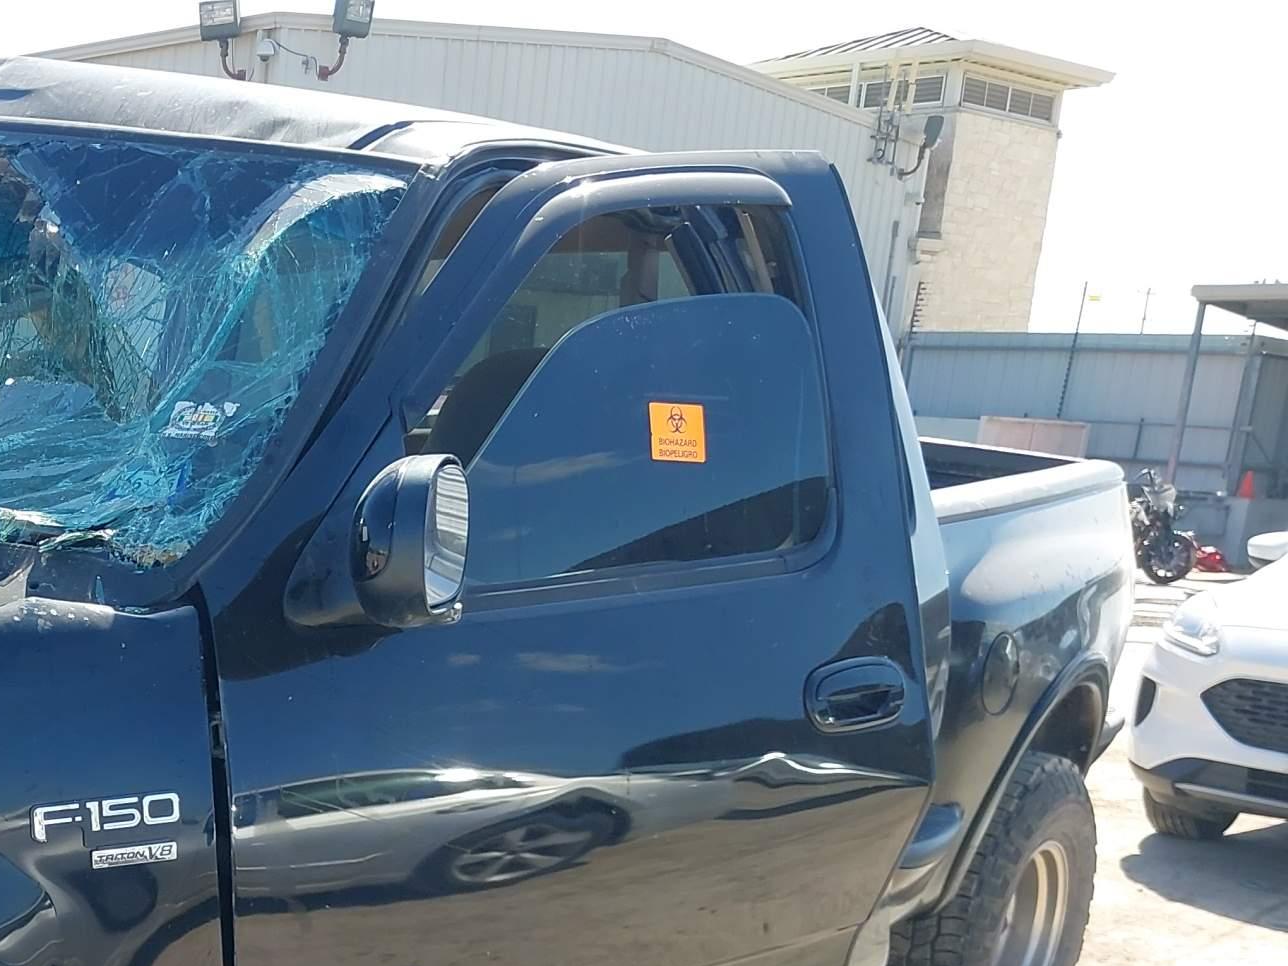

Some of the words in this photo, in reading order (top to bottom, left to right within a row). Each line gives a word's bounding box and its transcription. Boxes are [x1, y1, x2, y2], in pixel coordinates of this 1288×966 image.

[658, 436, 697, 448] BIOHAZARD
[658, 448, 698, 459] BIOPELIGRO
[33, 792, 180, 842] F-150
[95, 850, 146, 864] TRITON
[147, 844, 174, 861] V8
